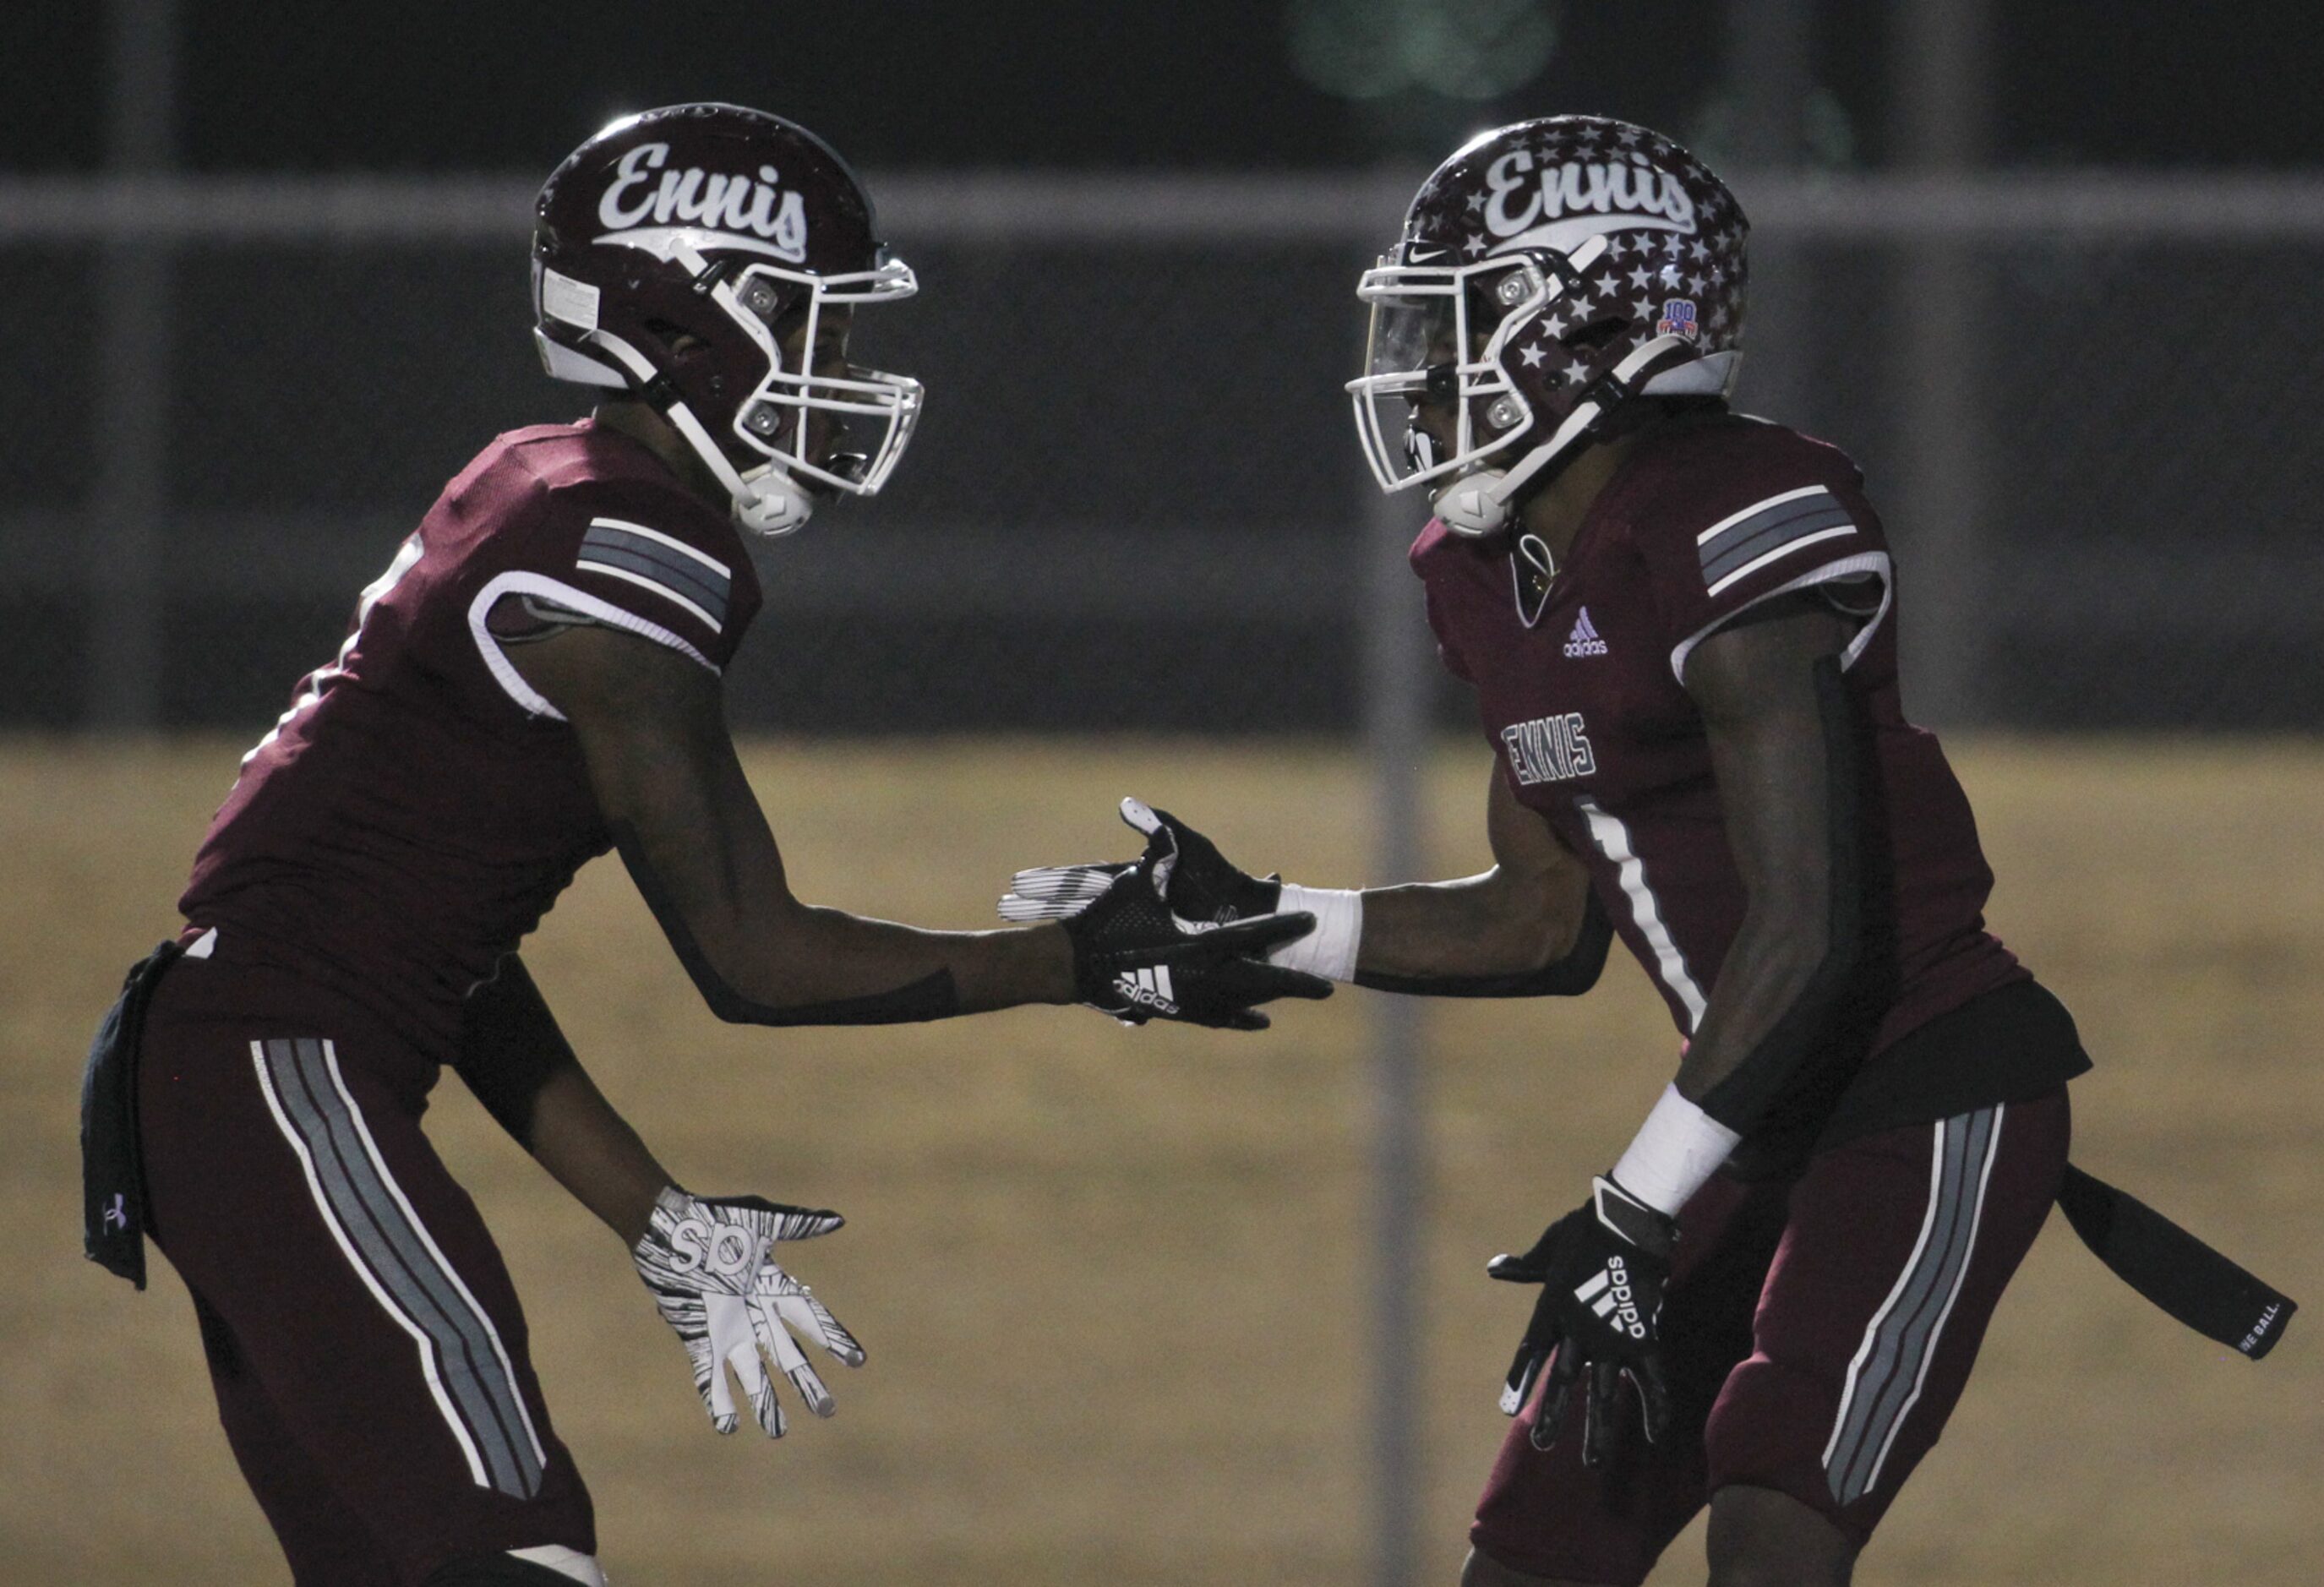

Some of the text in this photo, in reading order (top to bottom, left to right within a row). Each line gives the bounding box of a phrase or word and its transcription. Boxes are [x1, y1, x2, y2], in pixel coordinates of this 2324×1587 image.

[597, 141, 807, 260] Ennis
[1485, 150, 1698, 236] Ennis
[1665, 302, 1694, 321] 100
[1563, 638, 1608, 659] adidas
[1500, 712, 1596, 786] ENNIS
[1112, 978, 1181, 1016] adidas
[1607, 1255, 1647, 1340] adidas
